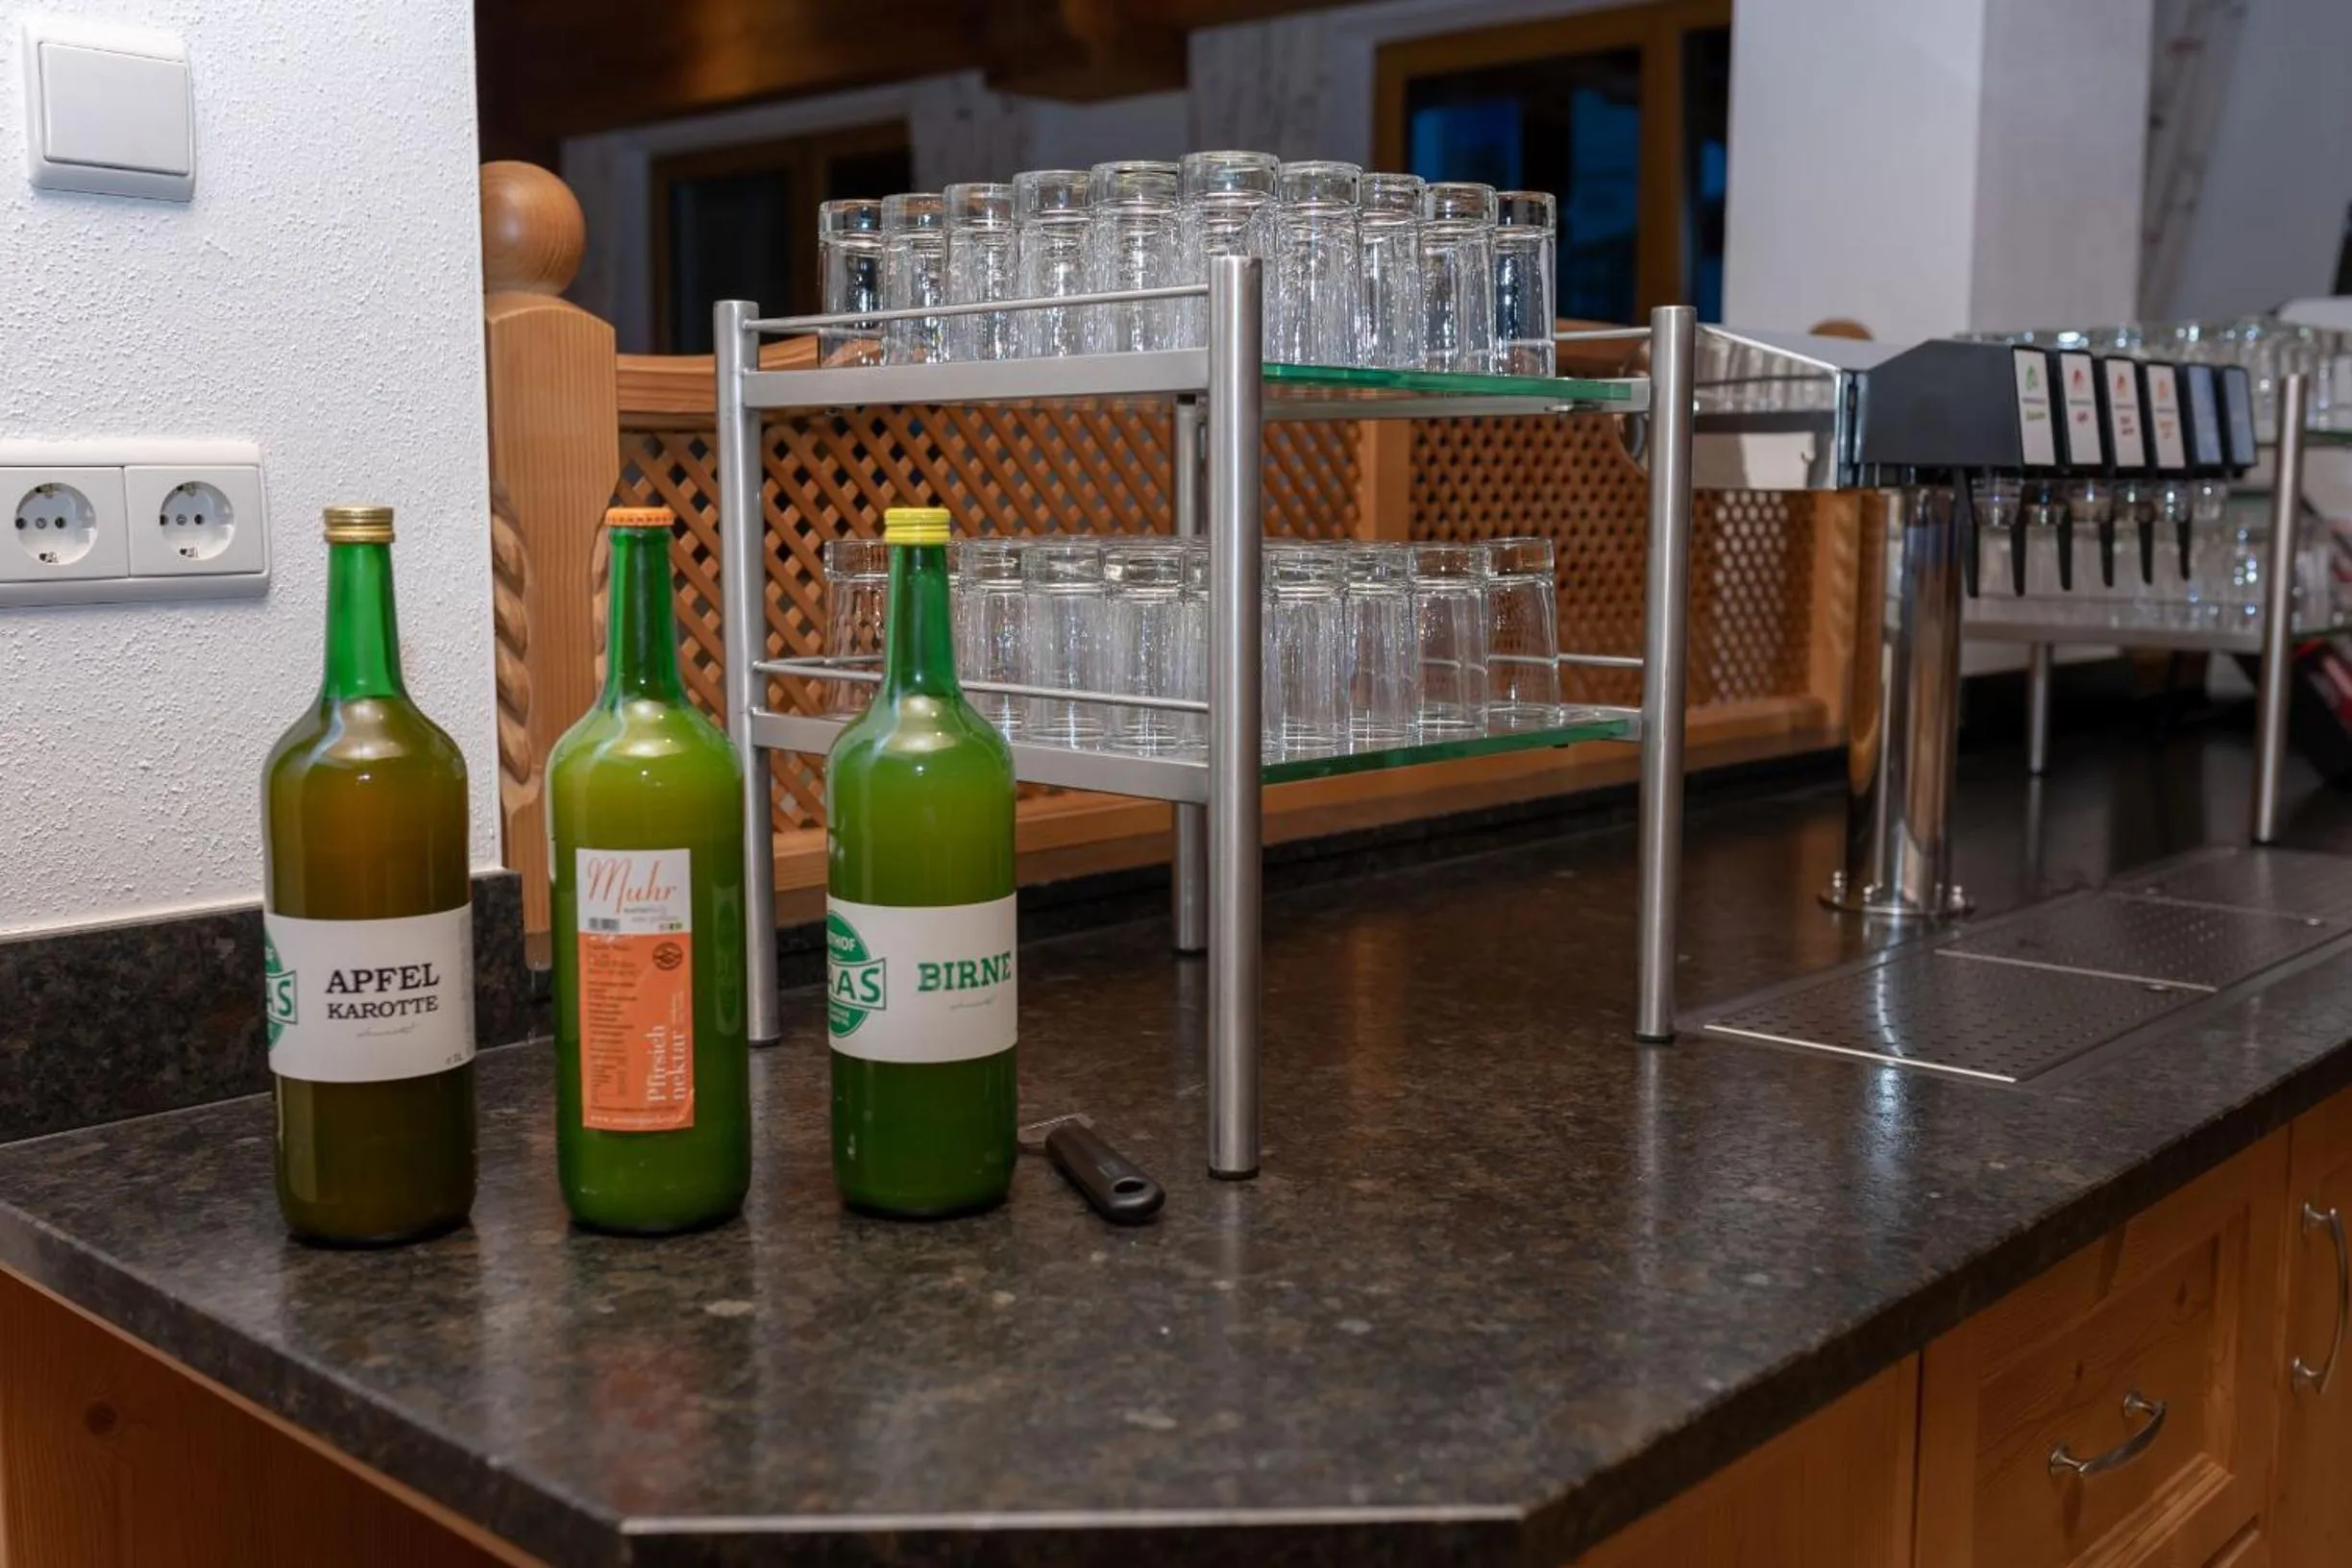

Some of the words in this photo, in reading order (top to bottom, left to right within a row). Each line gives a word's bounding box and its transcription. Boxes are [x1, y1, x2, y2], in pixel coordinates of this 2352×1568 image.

[587, 857, 677, 915] Muhr
[325, 963, 440, 994] APFEL
[918, 951, 1012, 992] BIRNE
[327, 995, 439, 1019] KAROTTE
[667, 1031, 686, 1100] nektar
